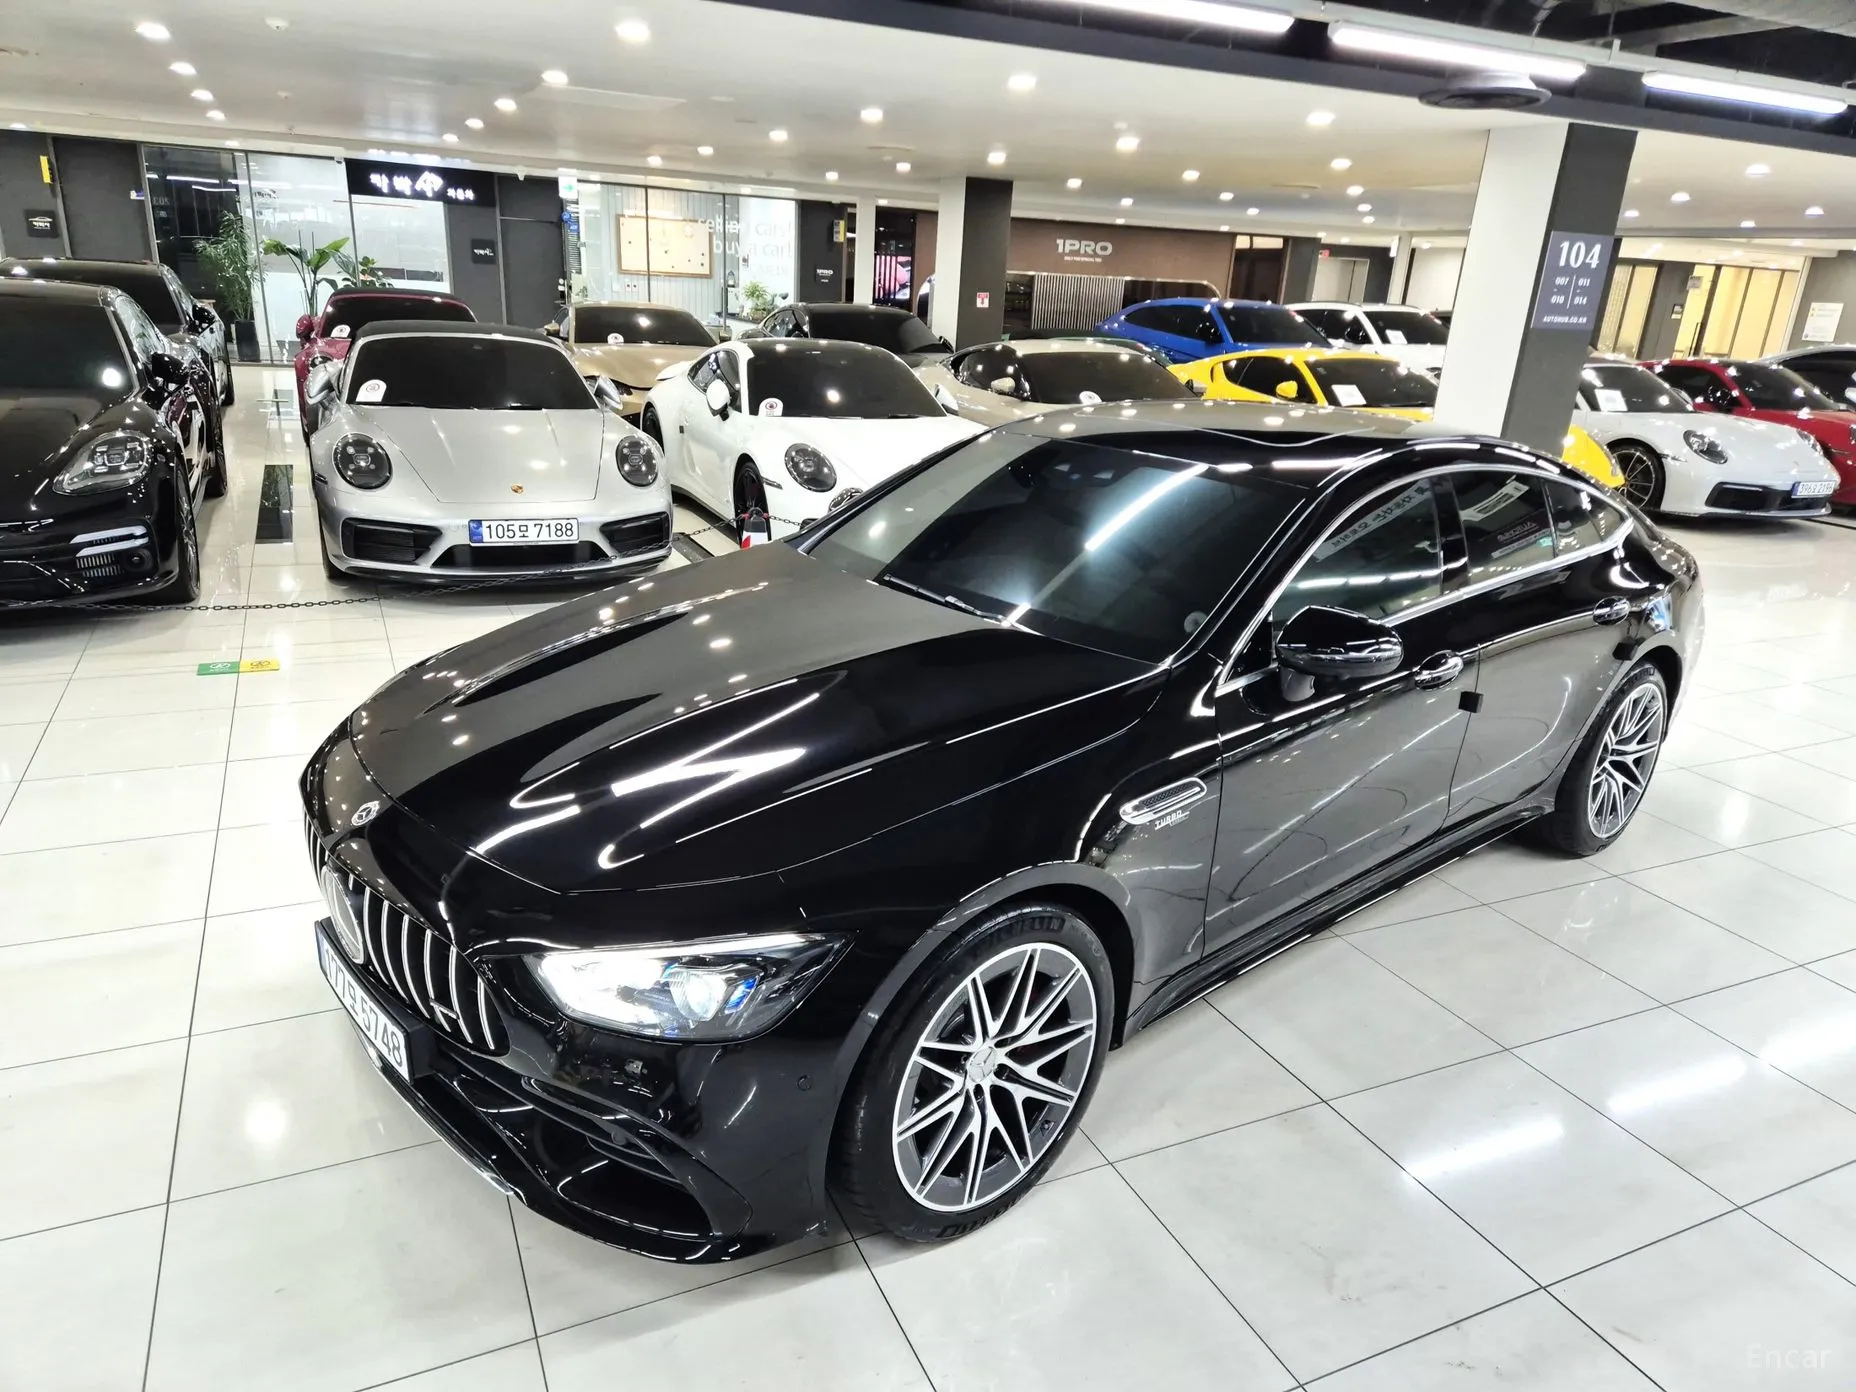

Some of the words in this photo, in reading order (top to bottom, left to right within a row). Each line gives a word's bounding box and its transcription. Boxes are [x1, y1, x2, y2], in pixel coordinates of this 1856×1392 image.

[713, 235, 743, 257] buy
[1056, 238, 1113, 256] 1PRO
[1559, 240, 1602, 269] 104
[1555, 276, 1570, 286] 007
[1578, 278, 1591, 287] 011
[1551, 295, 1565, 304] 010
[1573, 296, 1588, 305] 014
[485, 523, 530, 539] 105모
[533, 522, 574, 538] 7188
[326, 948, 359, 1016] 177모
[361, 995, 403, 1068] 5748
